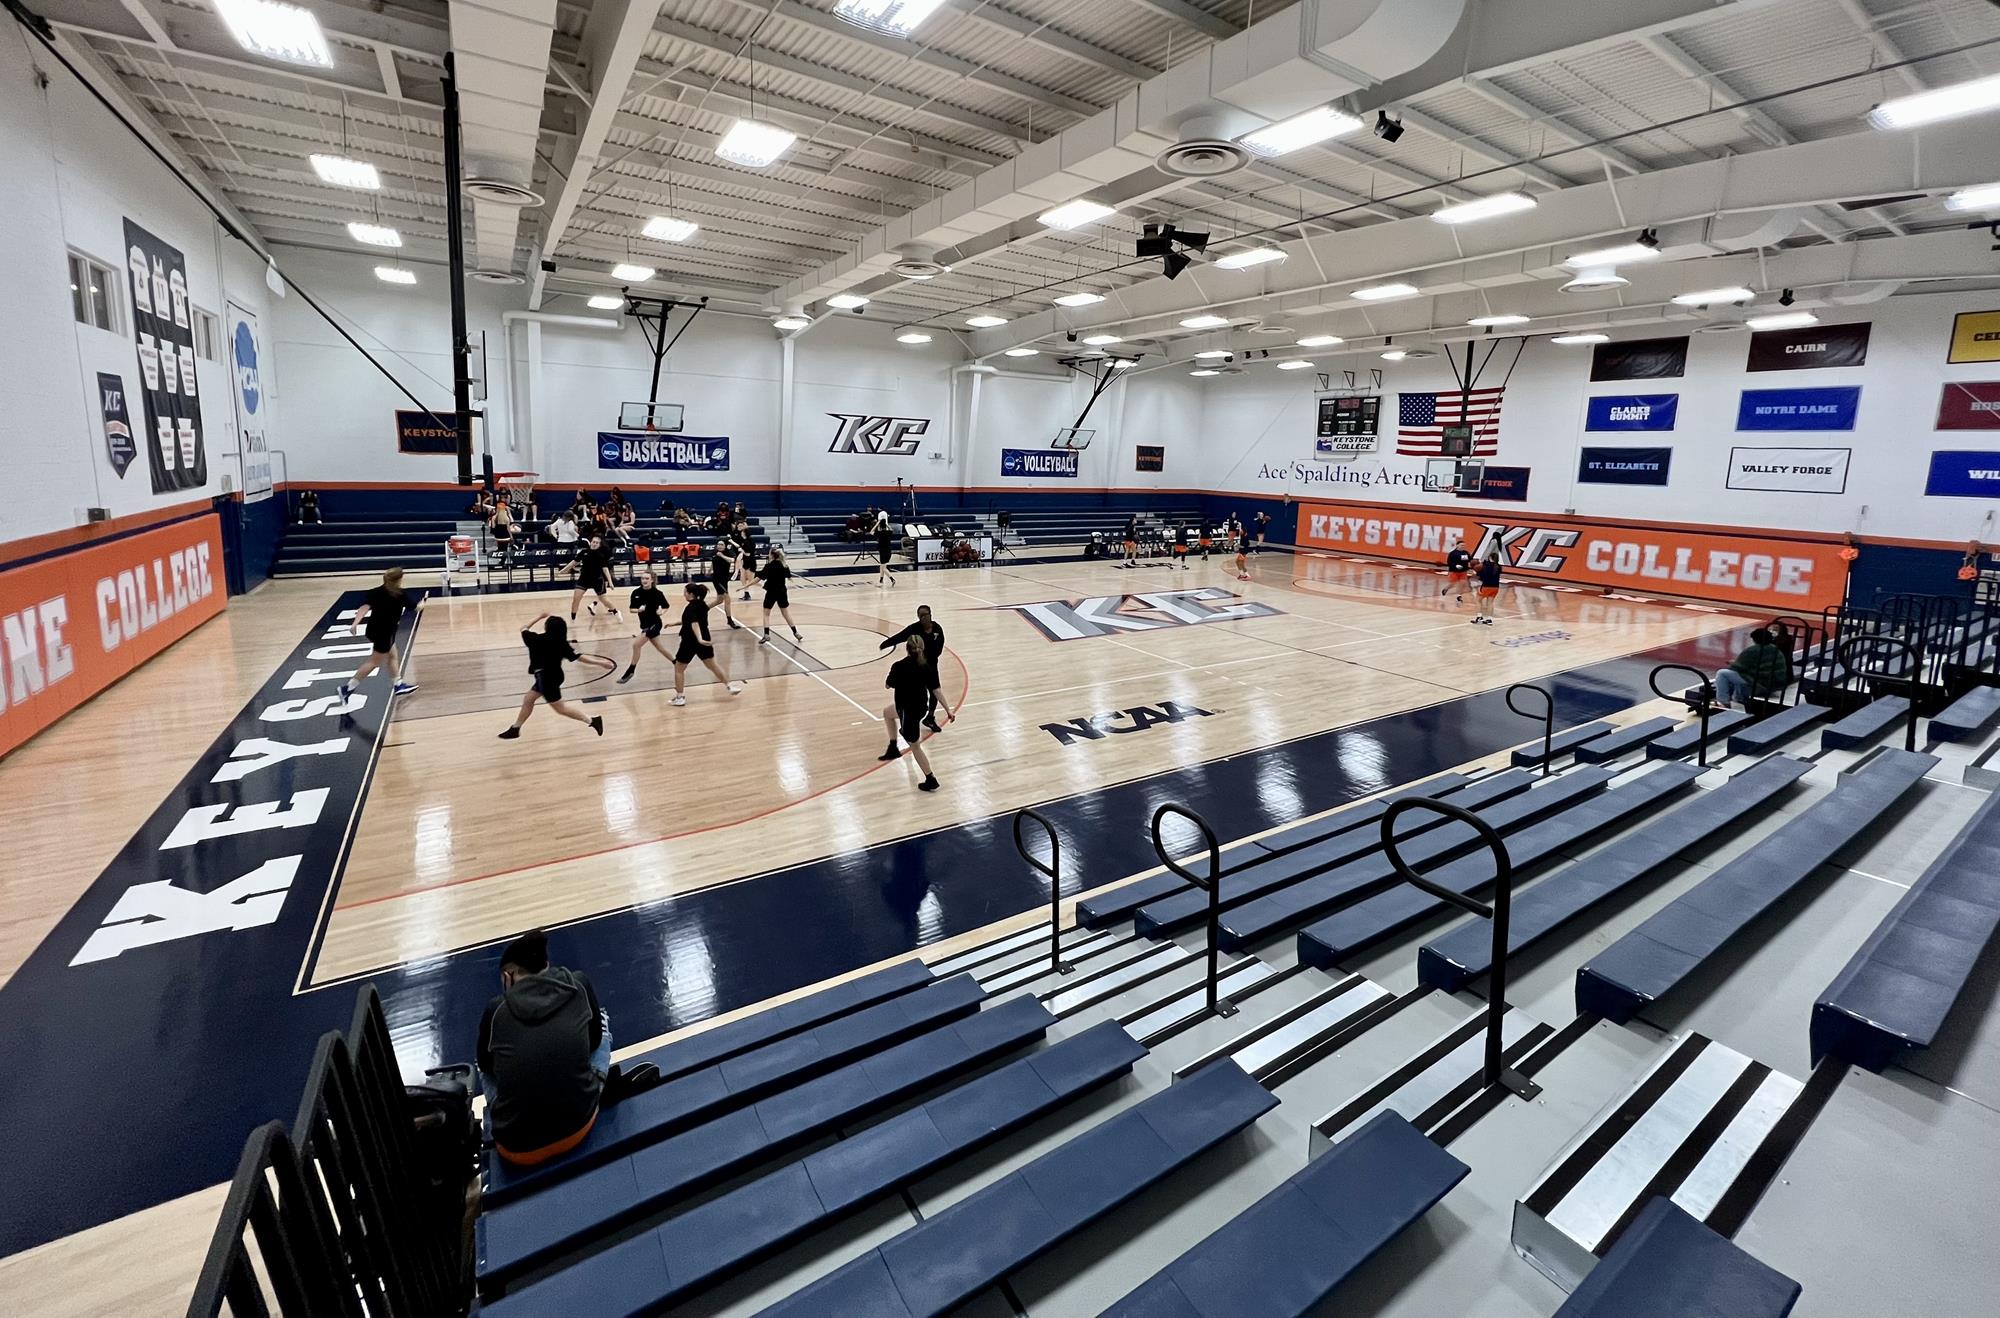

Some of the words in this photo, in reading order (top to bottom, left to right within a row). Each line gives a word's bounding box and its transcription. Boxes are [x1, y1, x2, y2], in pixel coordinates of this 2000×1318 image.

[1785, 343, 1827, 354] CAIRN
[104, 390, 121, 412] KC
[1610, 406, 1651, 414] CLARKS
[1755, 406, 1796, 415] NOTRE
[1799, 405, 1838, 414] DAME
[1609, 413, 1650, 421] SUMMIT
[403, 428, 457, 438] KEYSTO
[824, 412, 931, 456] KC
[622, 440, 711, 464] BASKETBALL
[1024, 455, 1076, 472] VOLLEYBALL
[1588, 462, 1604, 470] ST.
[1605, 462, 1660, 470] ELIZABETH
[1742, 464, 1789, 474] VALLEY
[1792, 465, 1833, 475] FORGE
[1294, 463, 1372, 488] Spalding
[1374, 466, 1439, 487] Arena
[1309, 513, 1465, 554] KEYSTONE
[1471, 521, 1584, 574] KC
[1586, 539, 1815, 595] COLLEGE
[970, 586, 1288, 643] KC
[0, 594, 74, 715] NE
[96, 541, 212, 652] COLLEGE
[1039, 701, 1214, 745] NCAA
